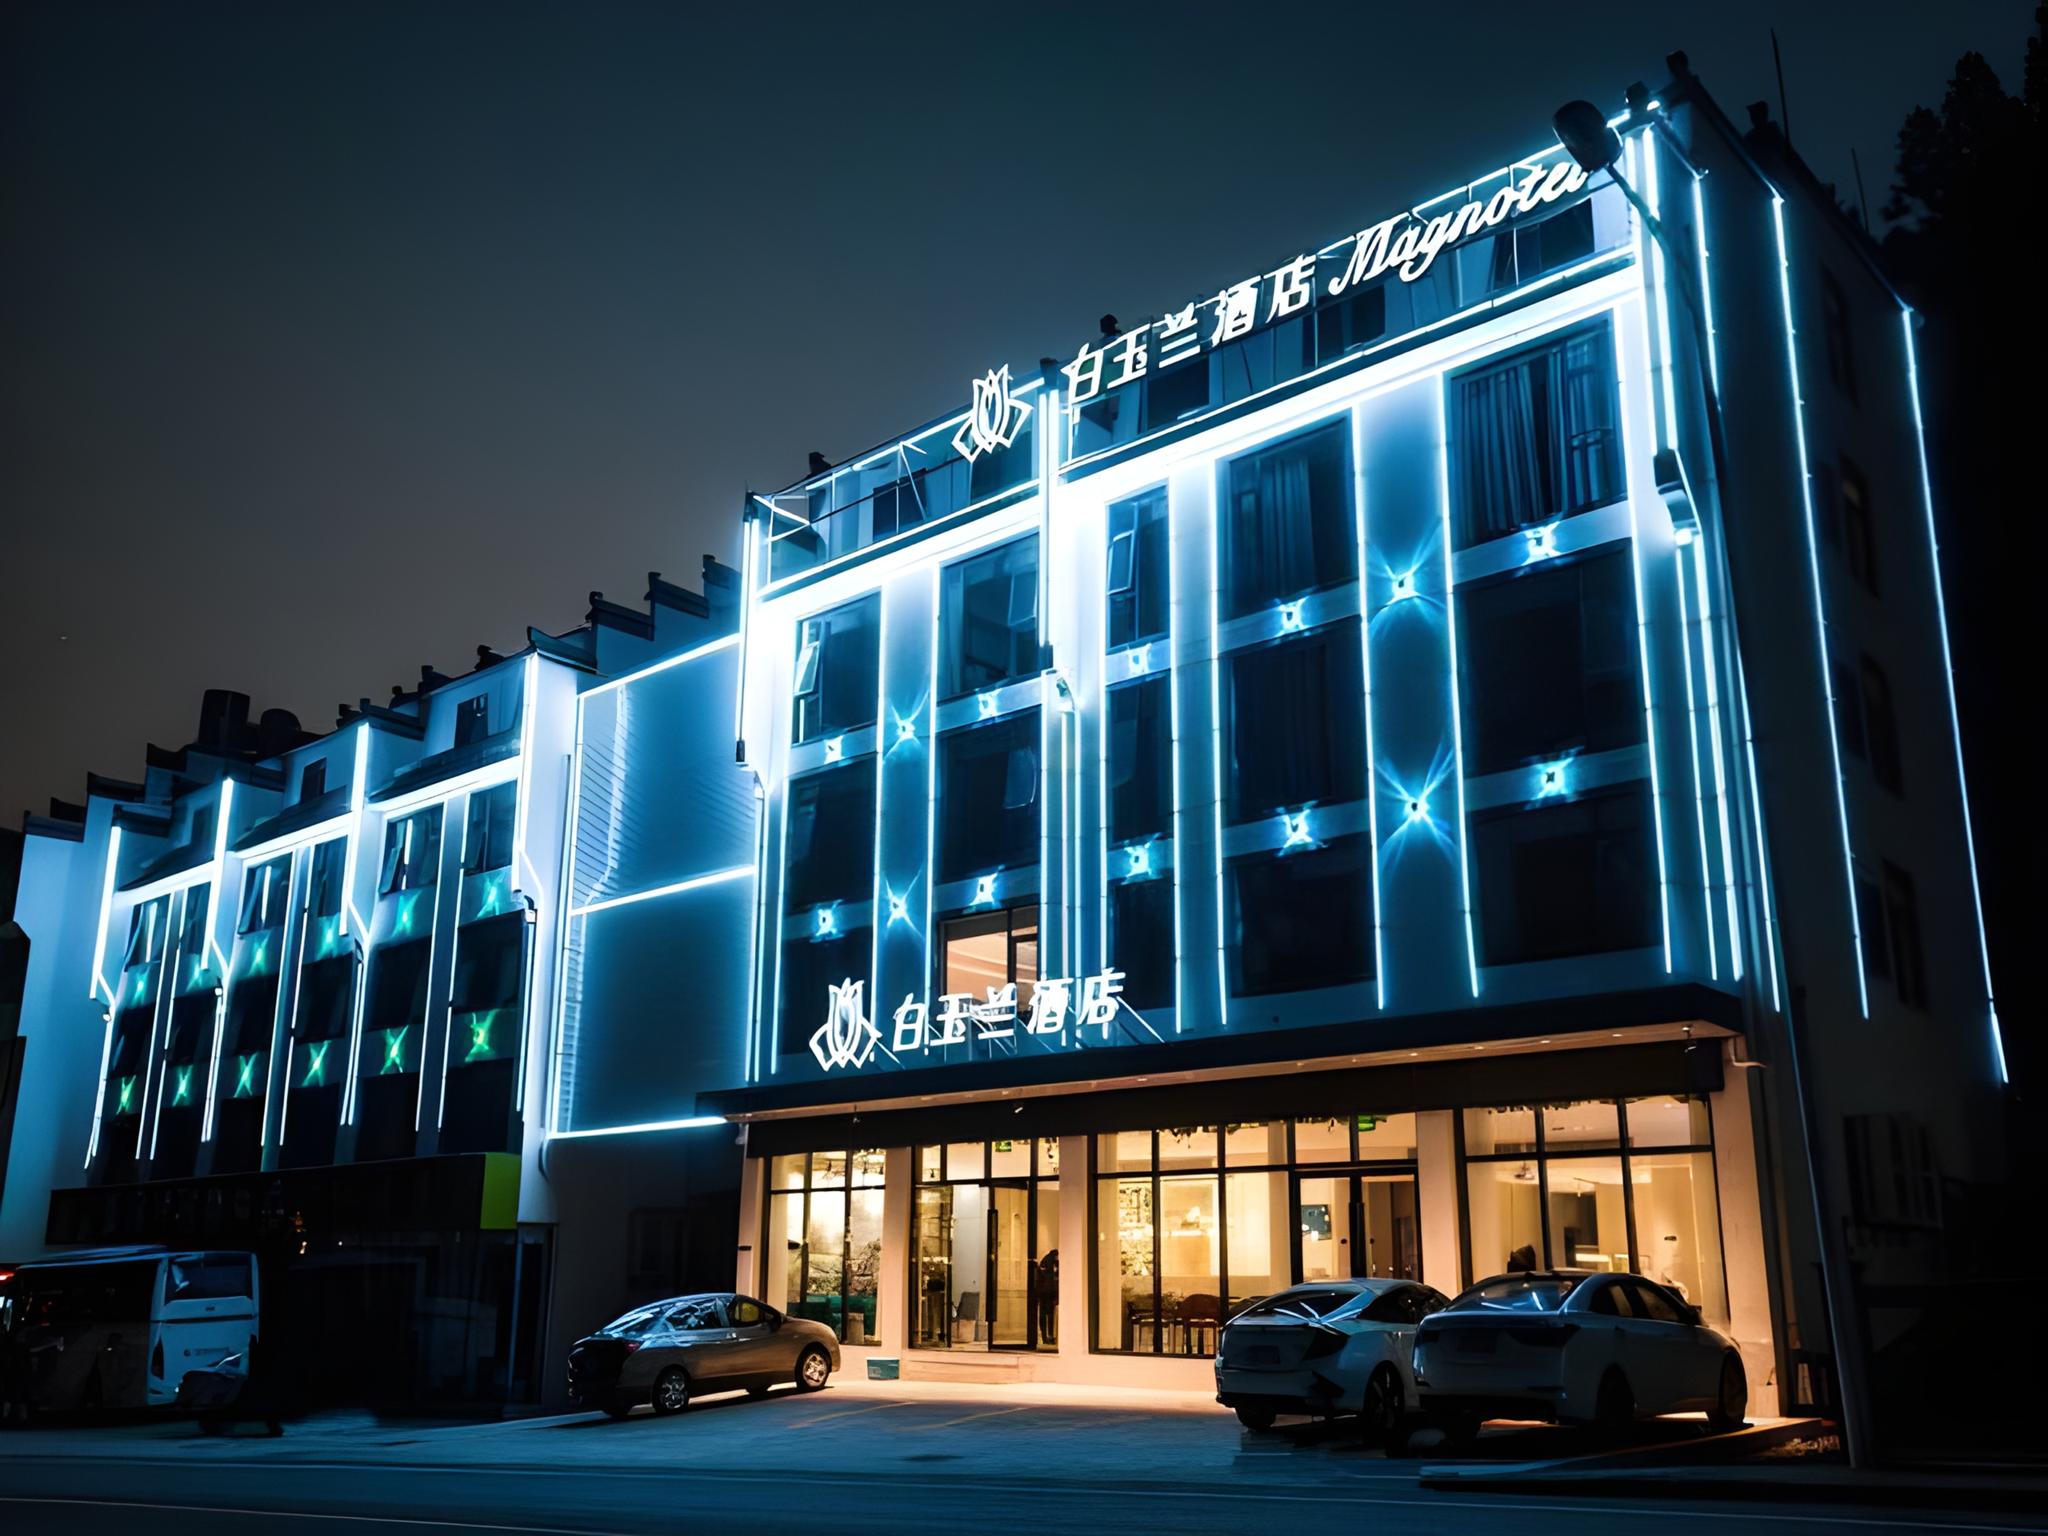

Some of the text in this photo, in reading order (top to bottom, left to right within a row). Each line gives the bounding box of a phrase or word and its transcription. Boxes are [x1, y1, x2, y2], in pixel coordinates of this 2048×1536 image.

[1060, 253, 1317, 404] 白玉兰酒店
[891, 967, 1126, 1052] 白玉兰酒店
